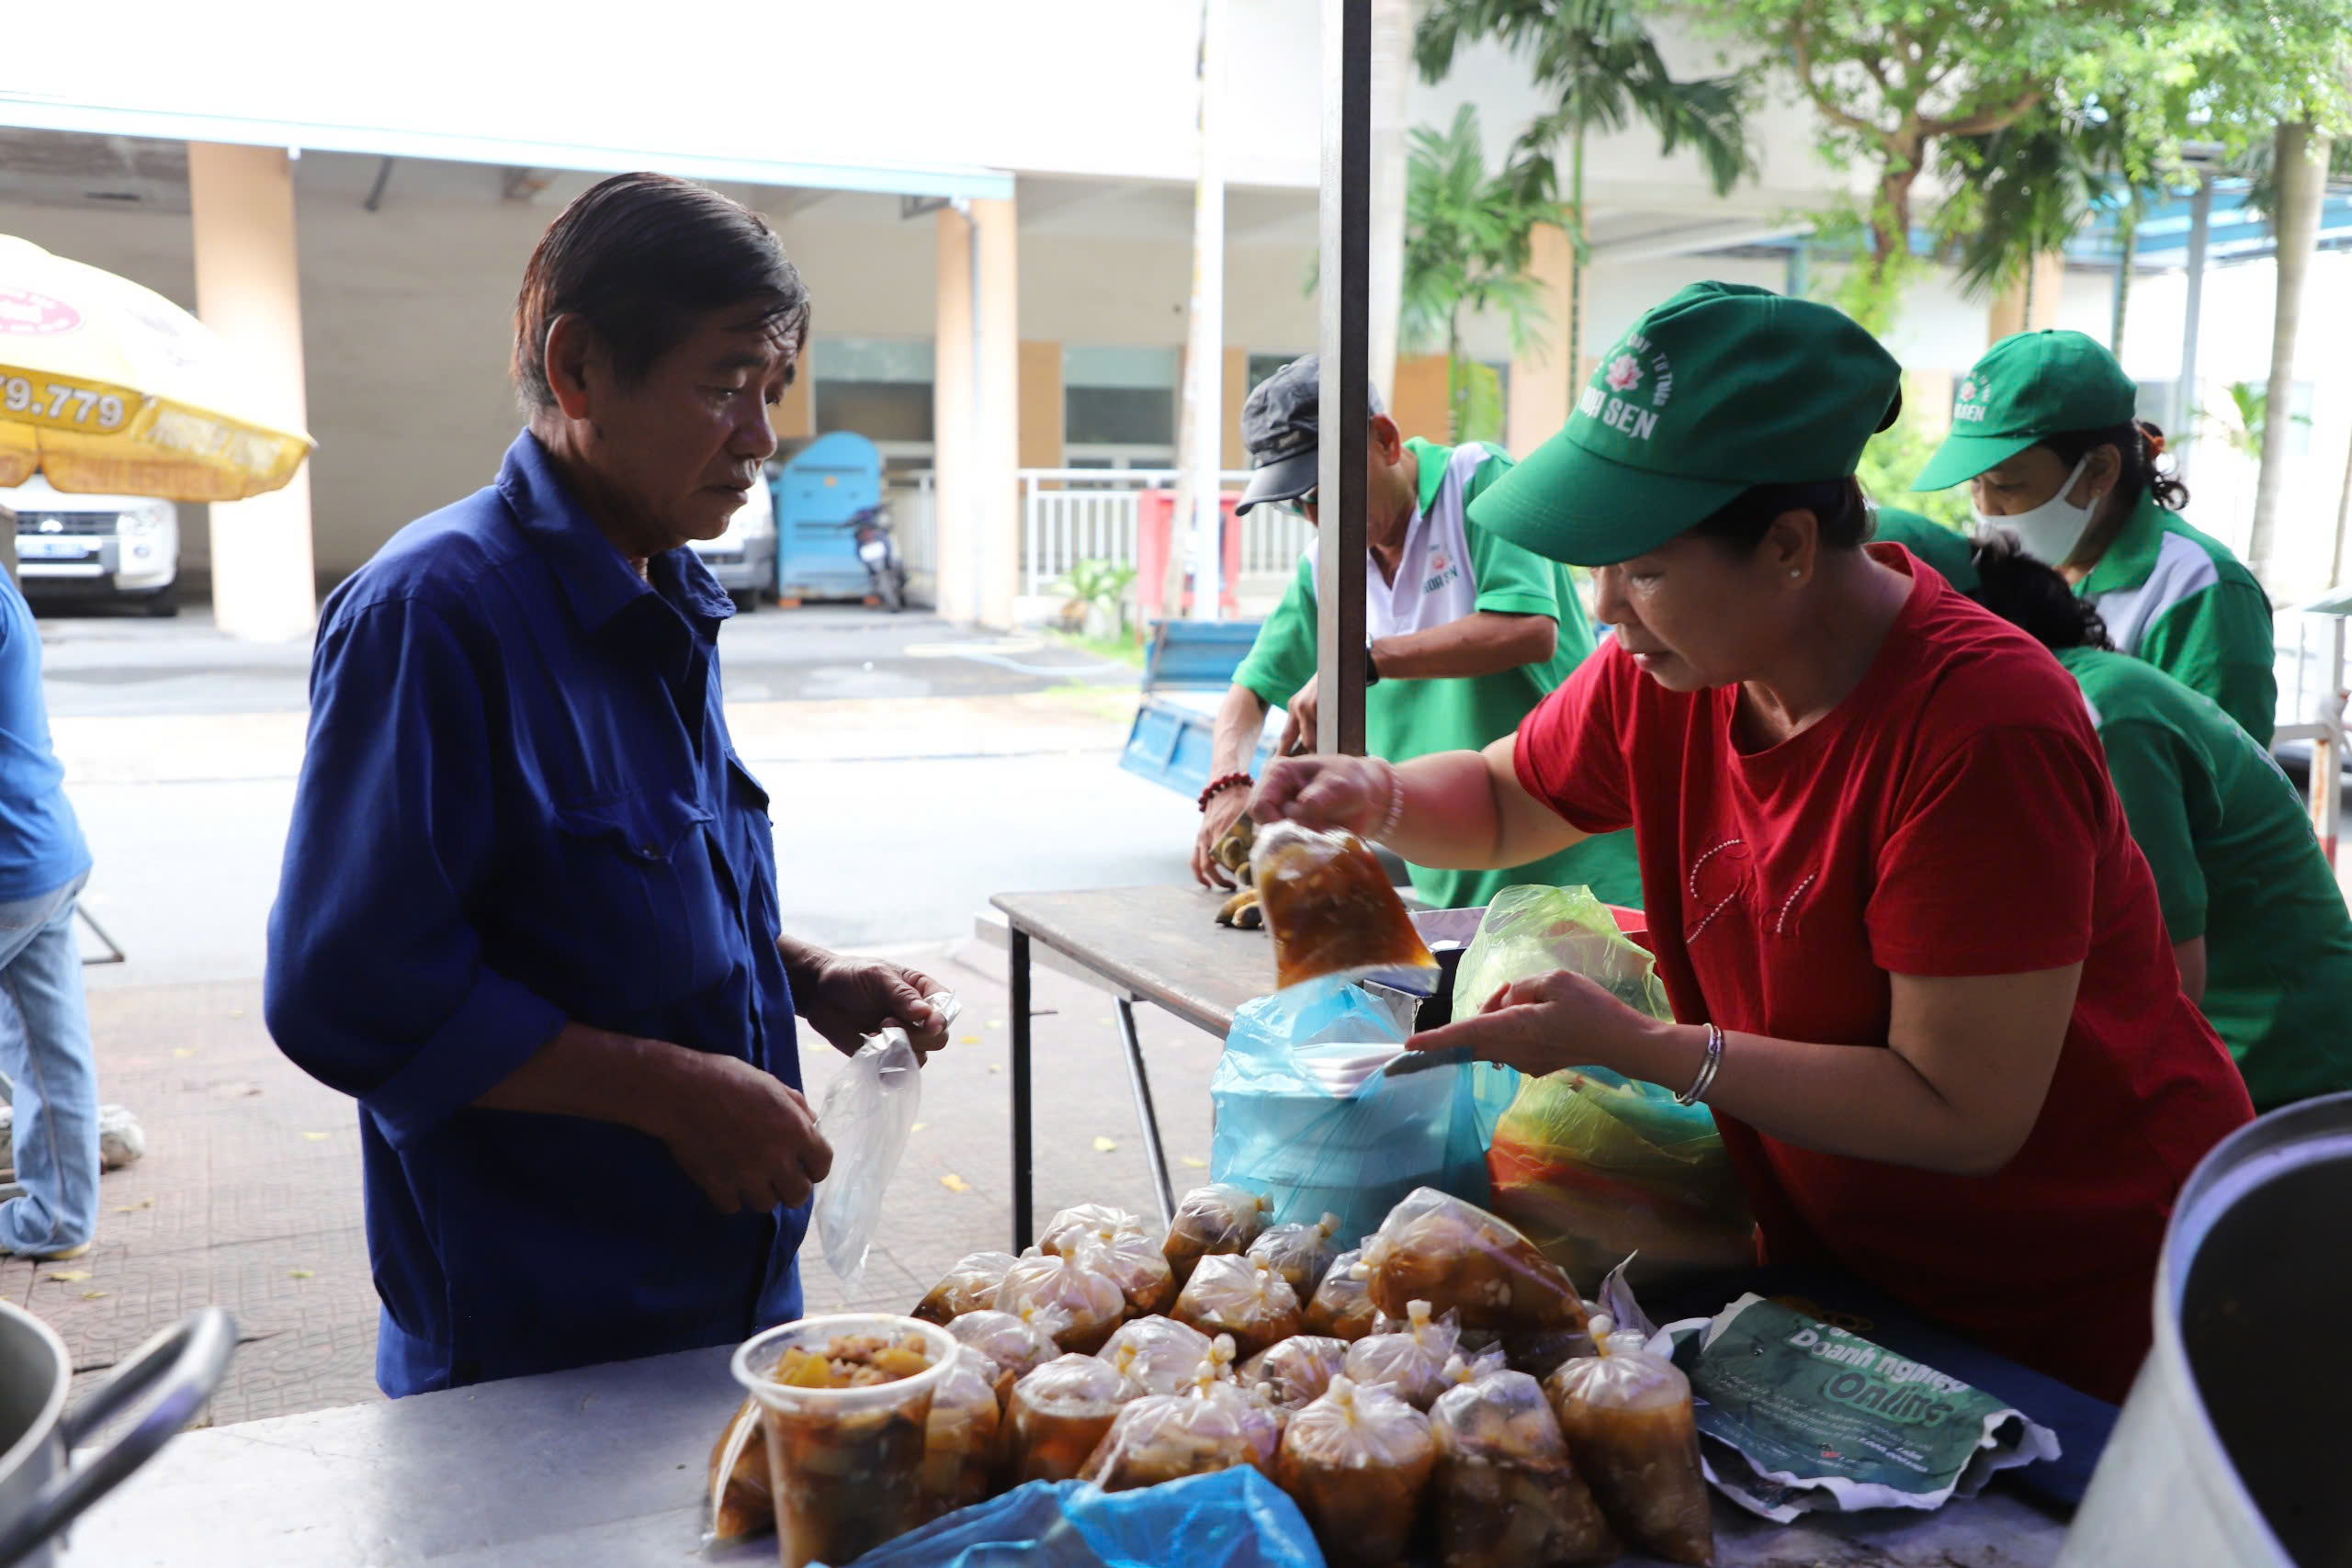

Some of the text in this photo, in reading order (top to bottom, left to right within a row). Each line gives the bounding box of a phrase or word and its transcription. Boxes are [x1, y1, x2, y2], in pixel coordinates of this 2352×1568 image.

[0, 371, 123, 427] 9.779
[1602, 397, 1659, 441] SEN
[1790, 1327, 1876, 1369] Doanh
